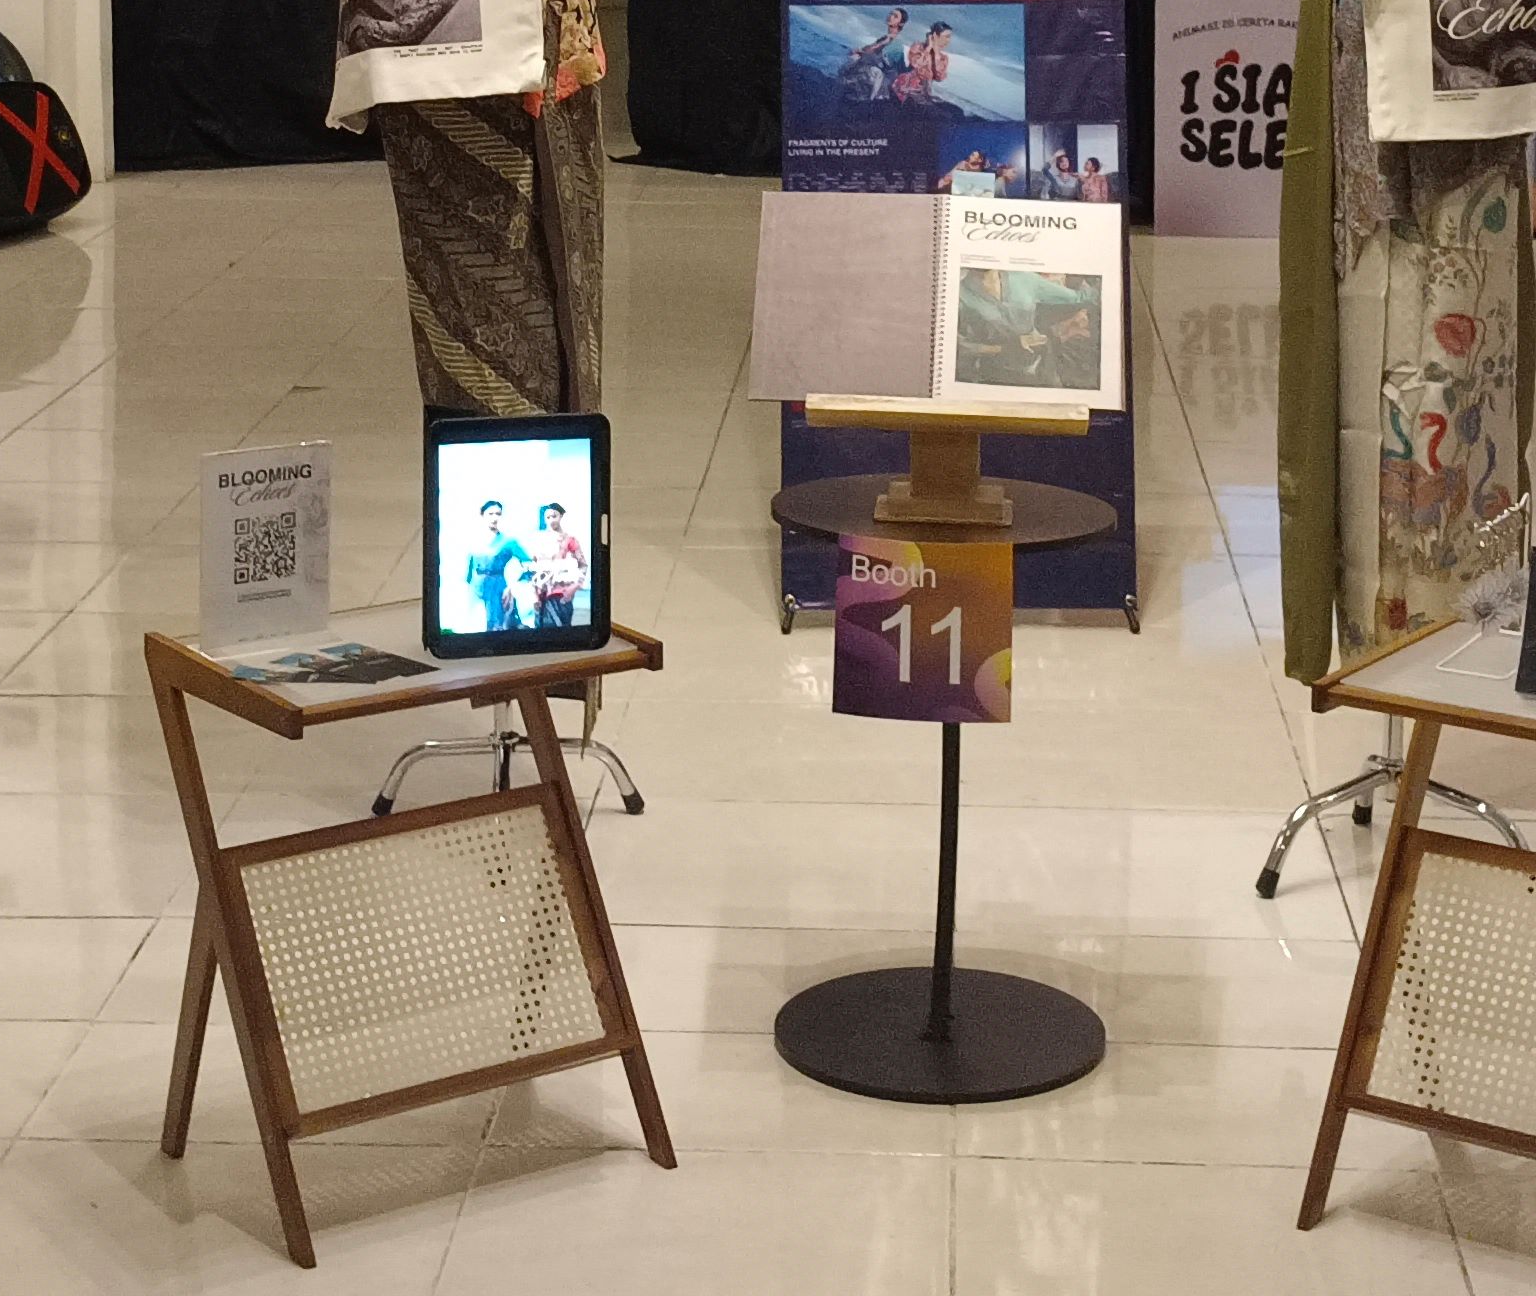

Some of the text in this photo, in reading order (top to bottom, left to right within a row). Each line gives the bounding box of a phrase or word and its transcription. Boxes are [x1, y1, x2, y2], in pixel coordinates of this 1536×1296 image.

[1179, 70, 1200, 115] I
[787, 138, 889, 147] FRAGMENTS OF CULTURE
[787, 149, 814, 157] LIVING
[842, 148, 880, 156] PRESENT
[961, 219, 1041, 243] Echoes
[964, 210, 1077, 231] BLOOMING
[218, 463, 313, 489] BLOOMING
[850, 553, 937, 589] Booth
[880, 603, 963, 686] 11
